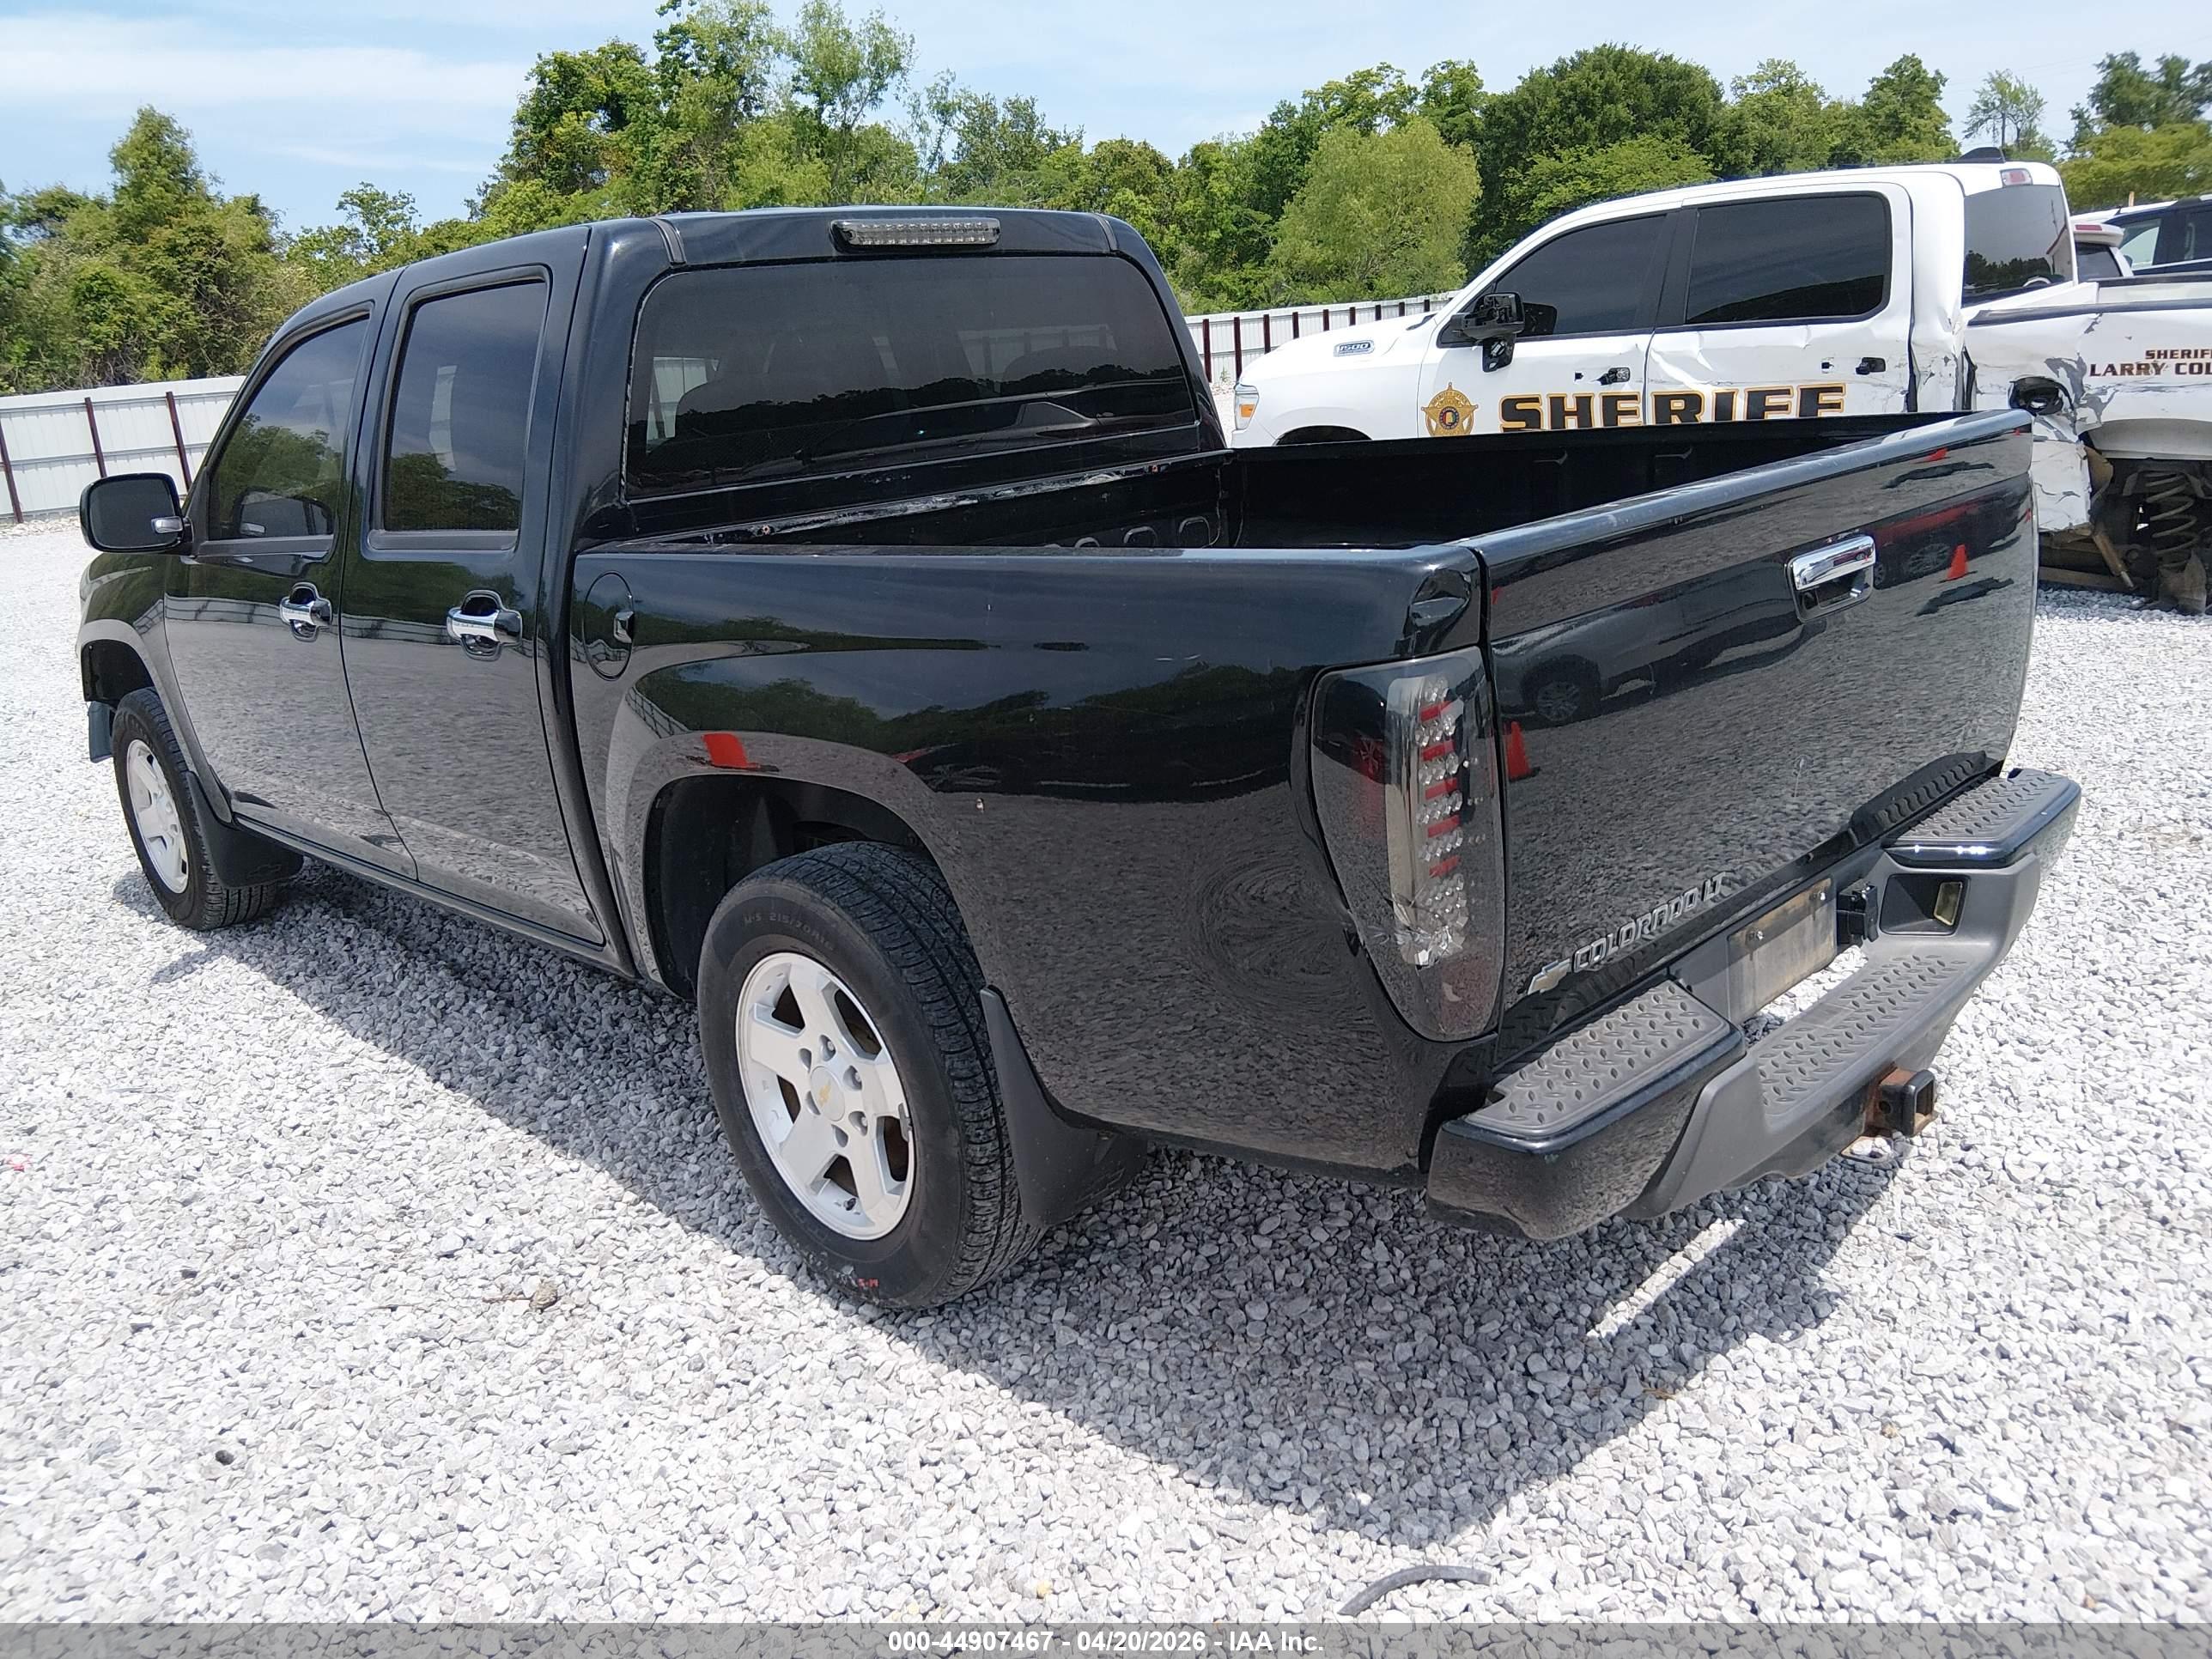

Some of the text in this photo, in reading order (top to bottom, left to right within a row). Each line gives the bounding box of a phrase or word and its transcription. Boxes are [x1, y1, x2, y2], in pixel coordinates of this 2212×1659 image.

[2089, 362, 2164, 377] LARRY
[2145, 349, 2212, 360] SHERIF
[1498, 382, 1847, 433] SHERIFF
[1573, 871, 1729, 973] COLORADO LT
